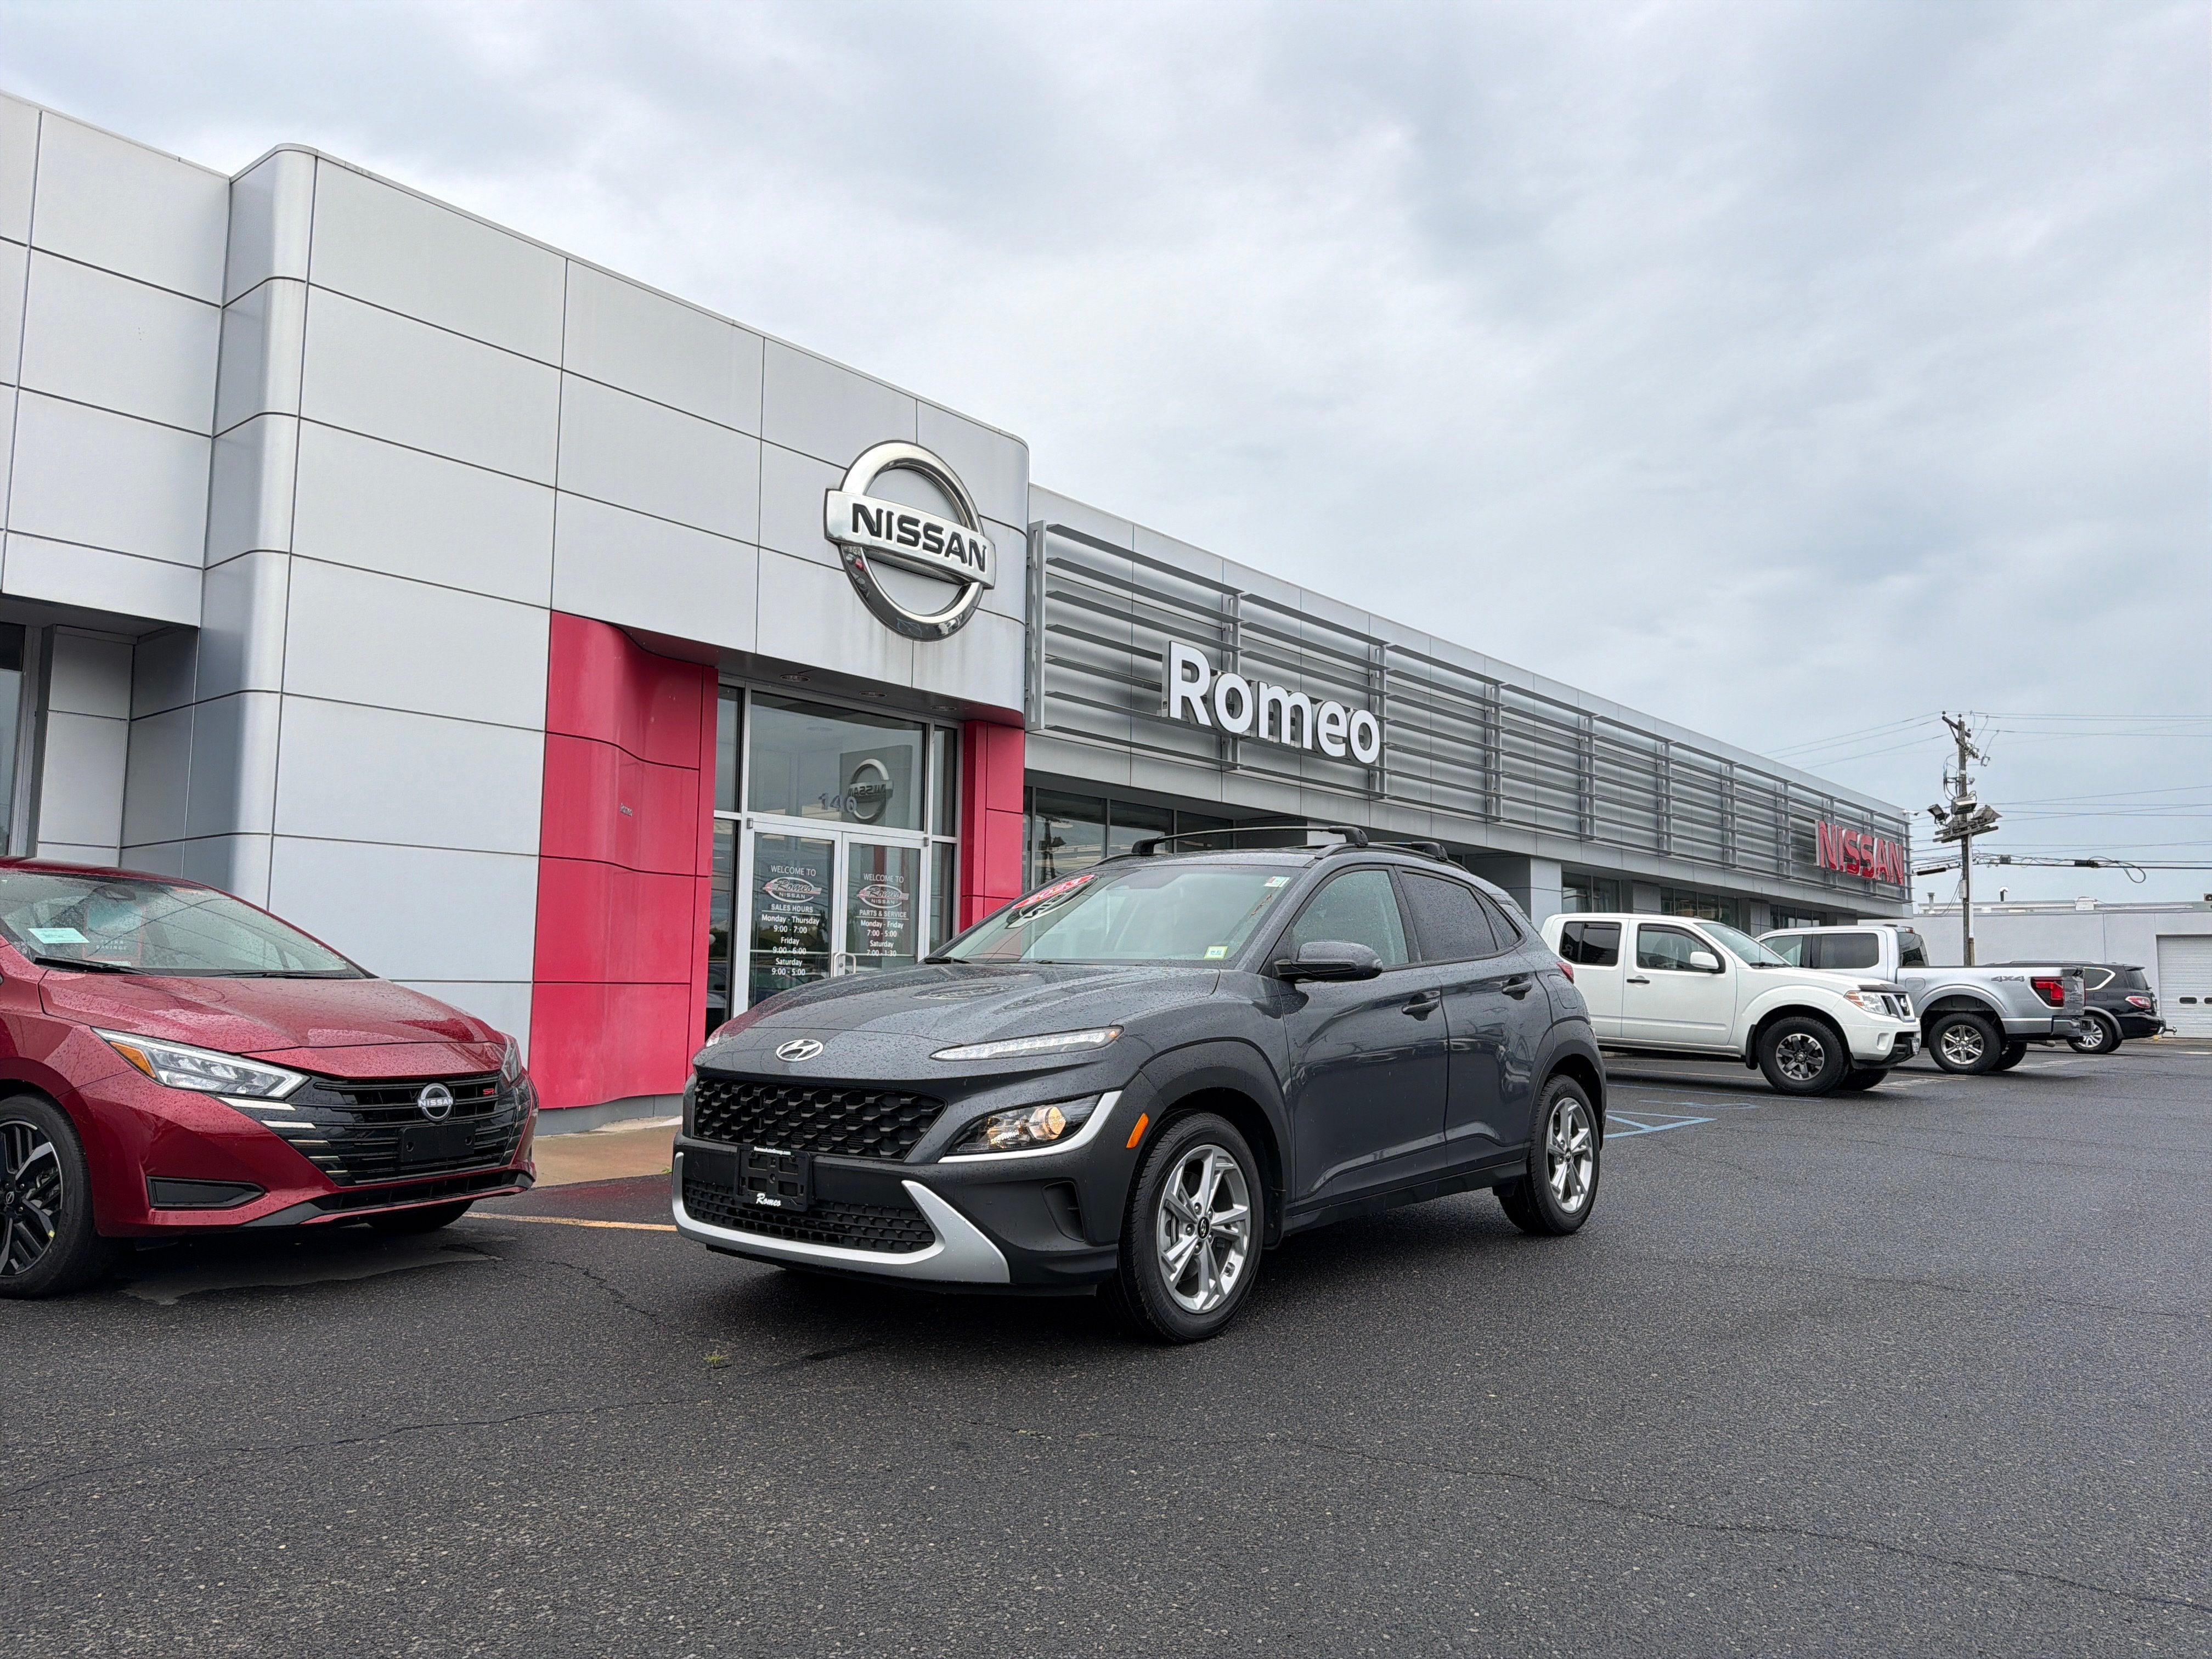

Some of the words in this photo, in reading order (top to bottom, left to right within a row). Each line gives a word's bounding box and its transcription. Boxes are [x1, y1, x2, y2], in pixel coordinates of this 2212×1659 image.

[852, 503, 986, 573] NISSAN
[1169, 640, 1380, 764] Romeo
[818, 792, 857, 812] 140
[1818, 820, 1904, 886] NISSAN
[771, 865, 804, 875] WELCOME
[863, 873, 893, 882] WELCOME
[774, 878, 812, 892] Romeo
[761, 914, 786, 923] Monday
[792, 916, 820, 926] Thursday
[860, 919, 882, 928] Monday
[887, 921, 904, 929] Friday
[781, 936, 799, 946] Friday
[870, 940, 894, 949] Saturday
[776, 957, 803, 967] Saturday
[419, 1098, 453, 1107] NISSAN
[756, 1193, 781, 1206] Romeo
